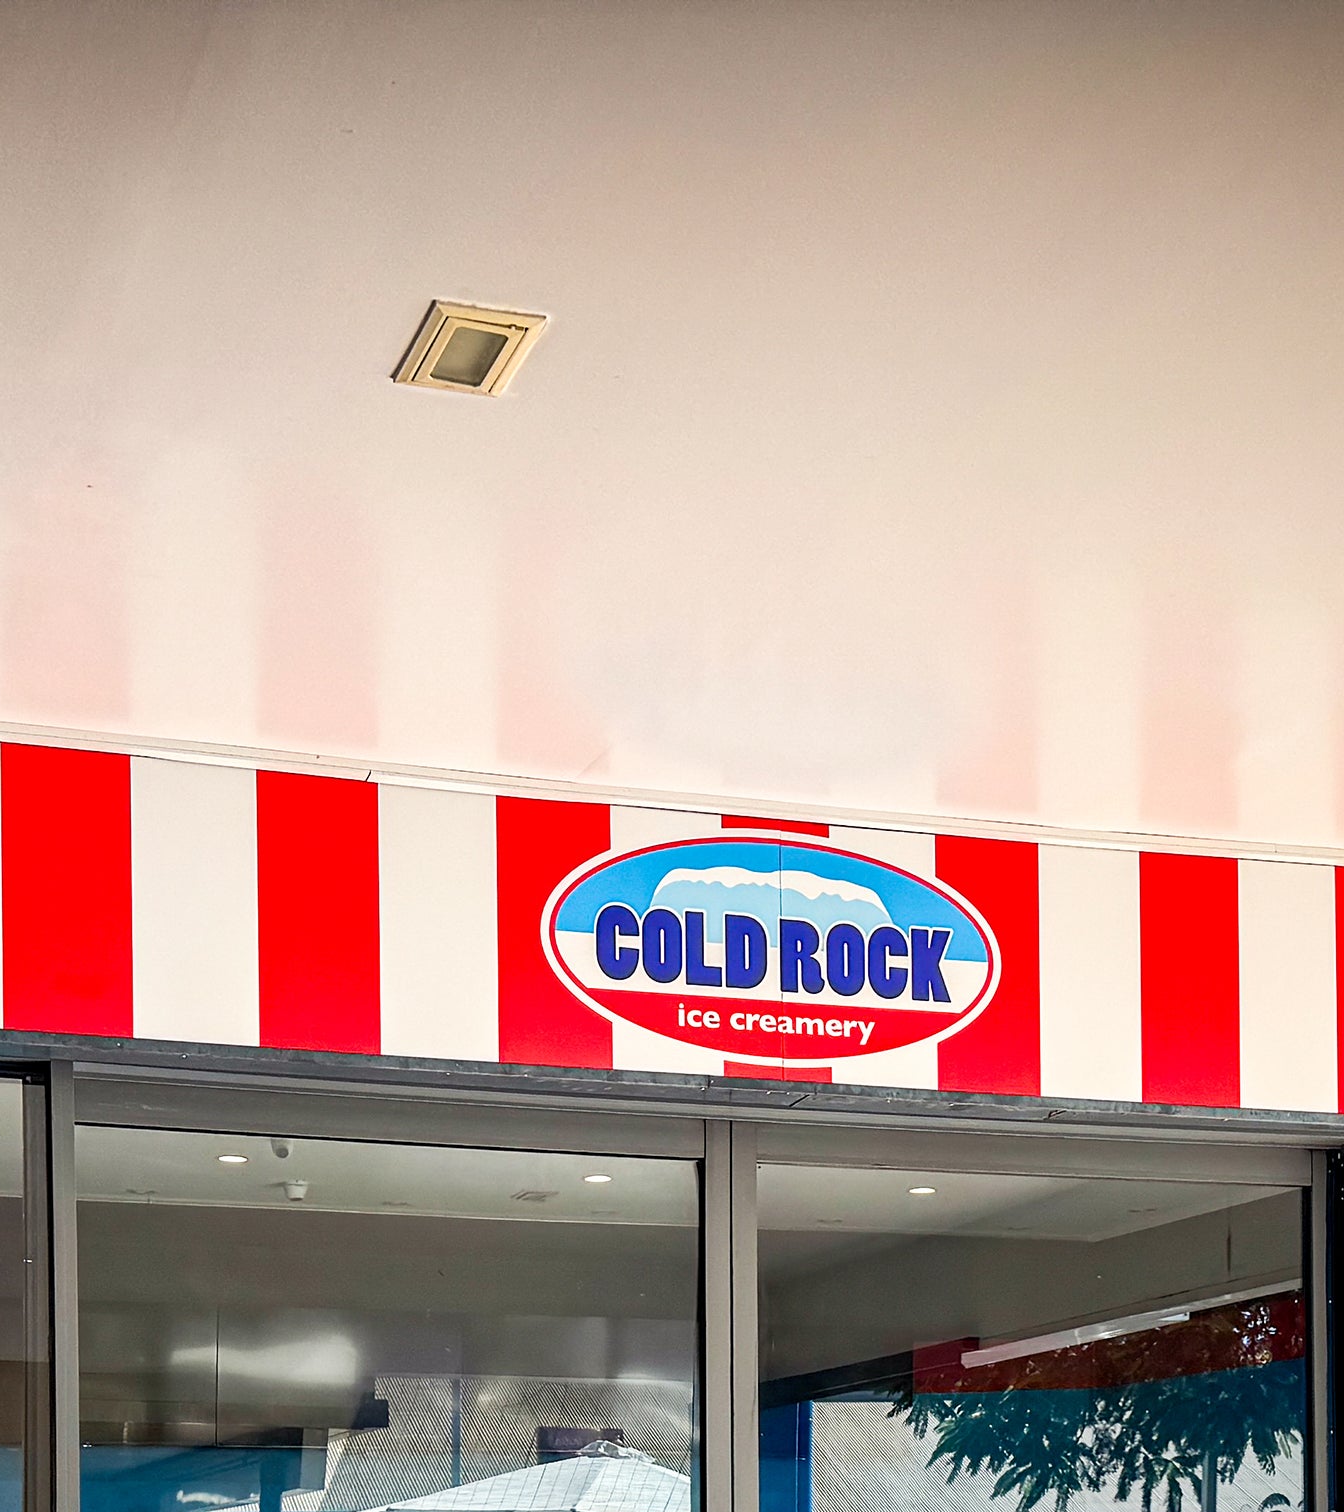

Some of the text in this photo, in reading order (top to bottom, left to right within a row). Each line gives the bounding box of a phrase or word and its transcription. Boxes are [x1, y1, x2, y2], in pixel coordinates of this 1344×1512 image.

[596, 905, 952, 1004] COLD ROCK
[677, 1003, 876, 1046] ice creamery
